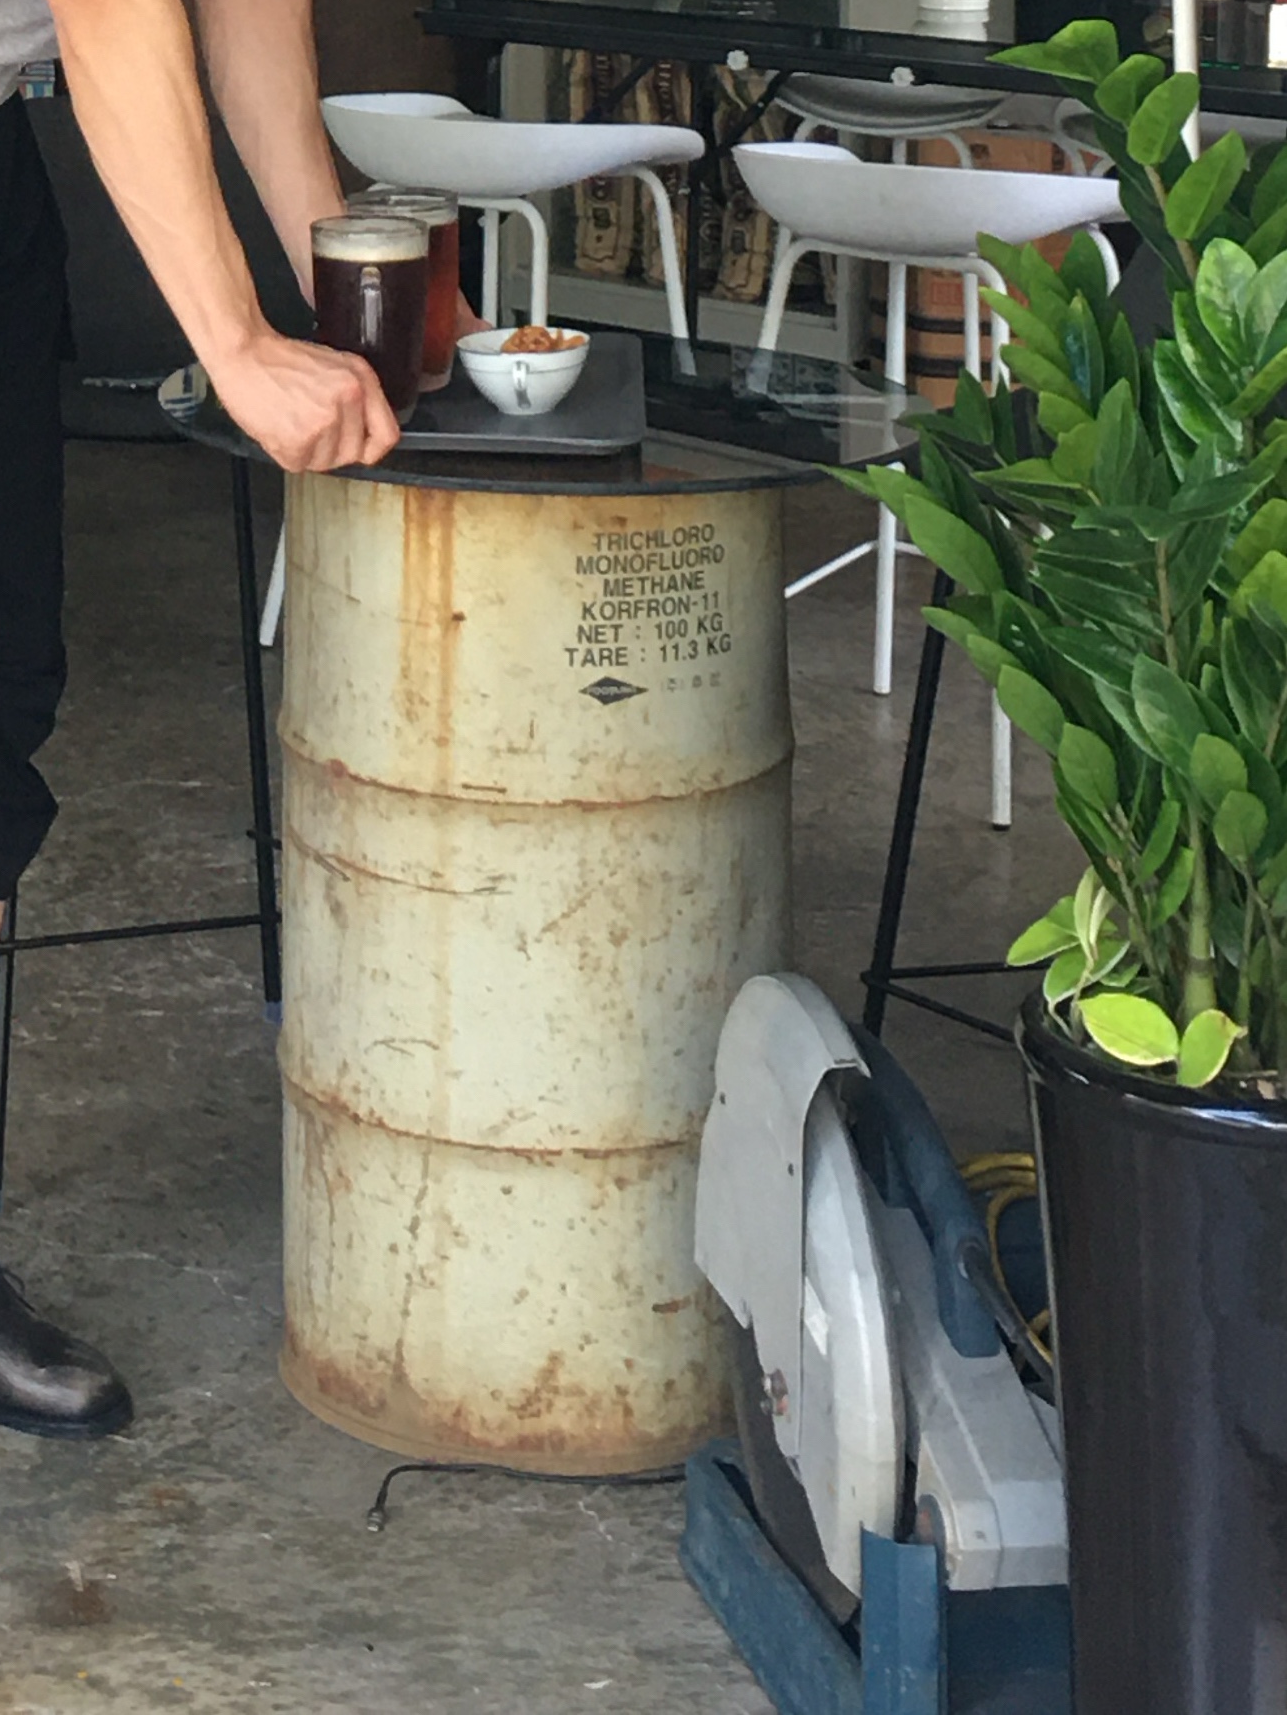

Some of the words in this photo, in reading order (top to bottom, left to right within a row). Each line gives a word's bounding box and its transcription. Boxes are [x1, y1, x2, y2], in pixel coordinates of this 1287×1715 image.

[593, 524, 715, 552] TRICHLORO
[576, 545, 725, 575] MONOFLUORO
[603, 570, 705, 598] METHANE
[581, 591, 720, 621] KORFRON-11
[576, 624, 623, 645] NET
[654, 619, 689, 641] 100
[697, 613, 723, 635] KG
[565, 647, 629, 668] TARE
[659, 640, 699, 663] 11.3
[706, 634, 732, 656] KG
